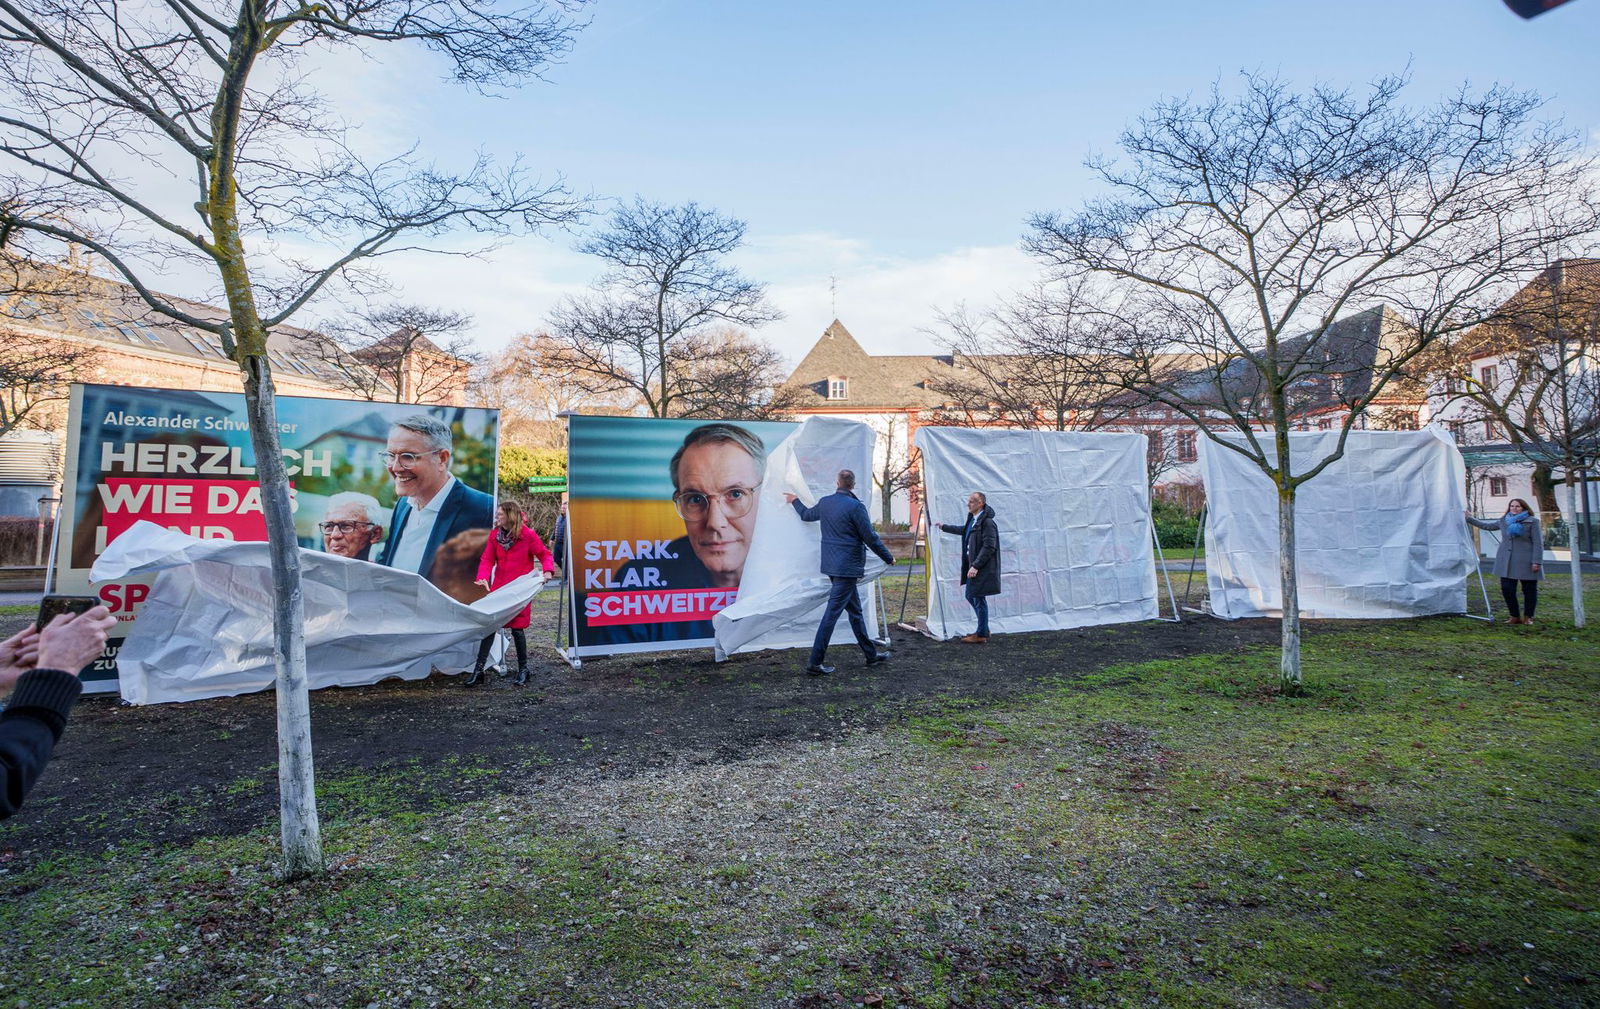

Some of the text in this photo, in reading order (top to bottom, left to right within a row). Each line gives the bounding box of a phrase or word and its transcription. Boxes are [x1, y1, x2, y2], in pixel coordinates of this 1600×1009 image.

[103, 411, 200, 429] Alexander
[101, 441, 332, 477] HERZLCH
[97, 483, 193, 514] WIE
[584, 540, 679, 561] STARK.
[584, 567, 668, 589] KLAR.
[99, 583, 150, 613] SP
[584, 591, 738, 618] SCHWEITZE
